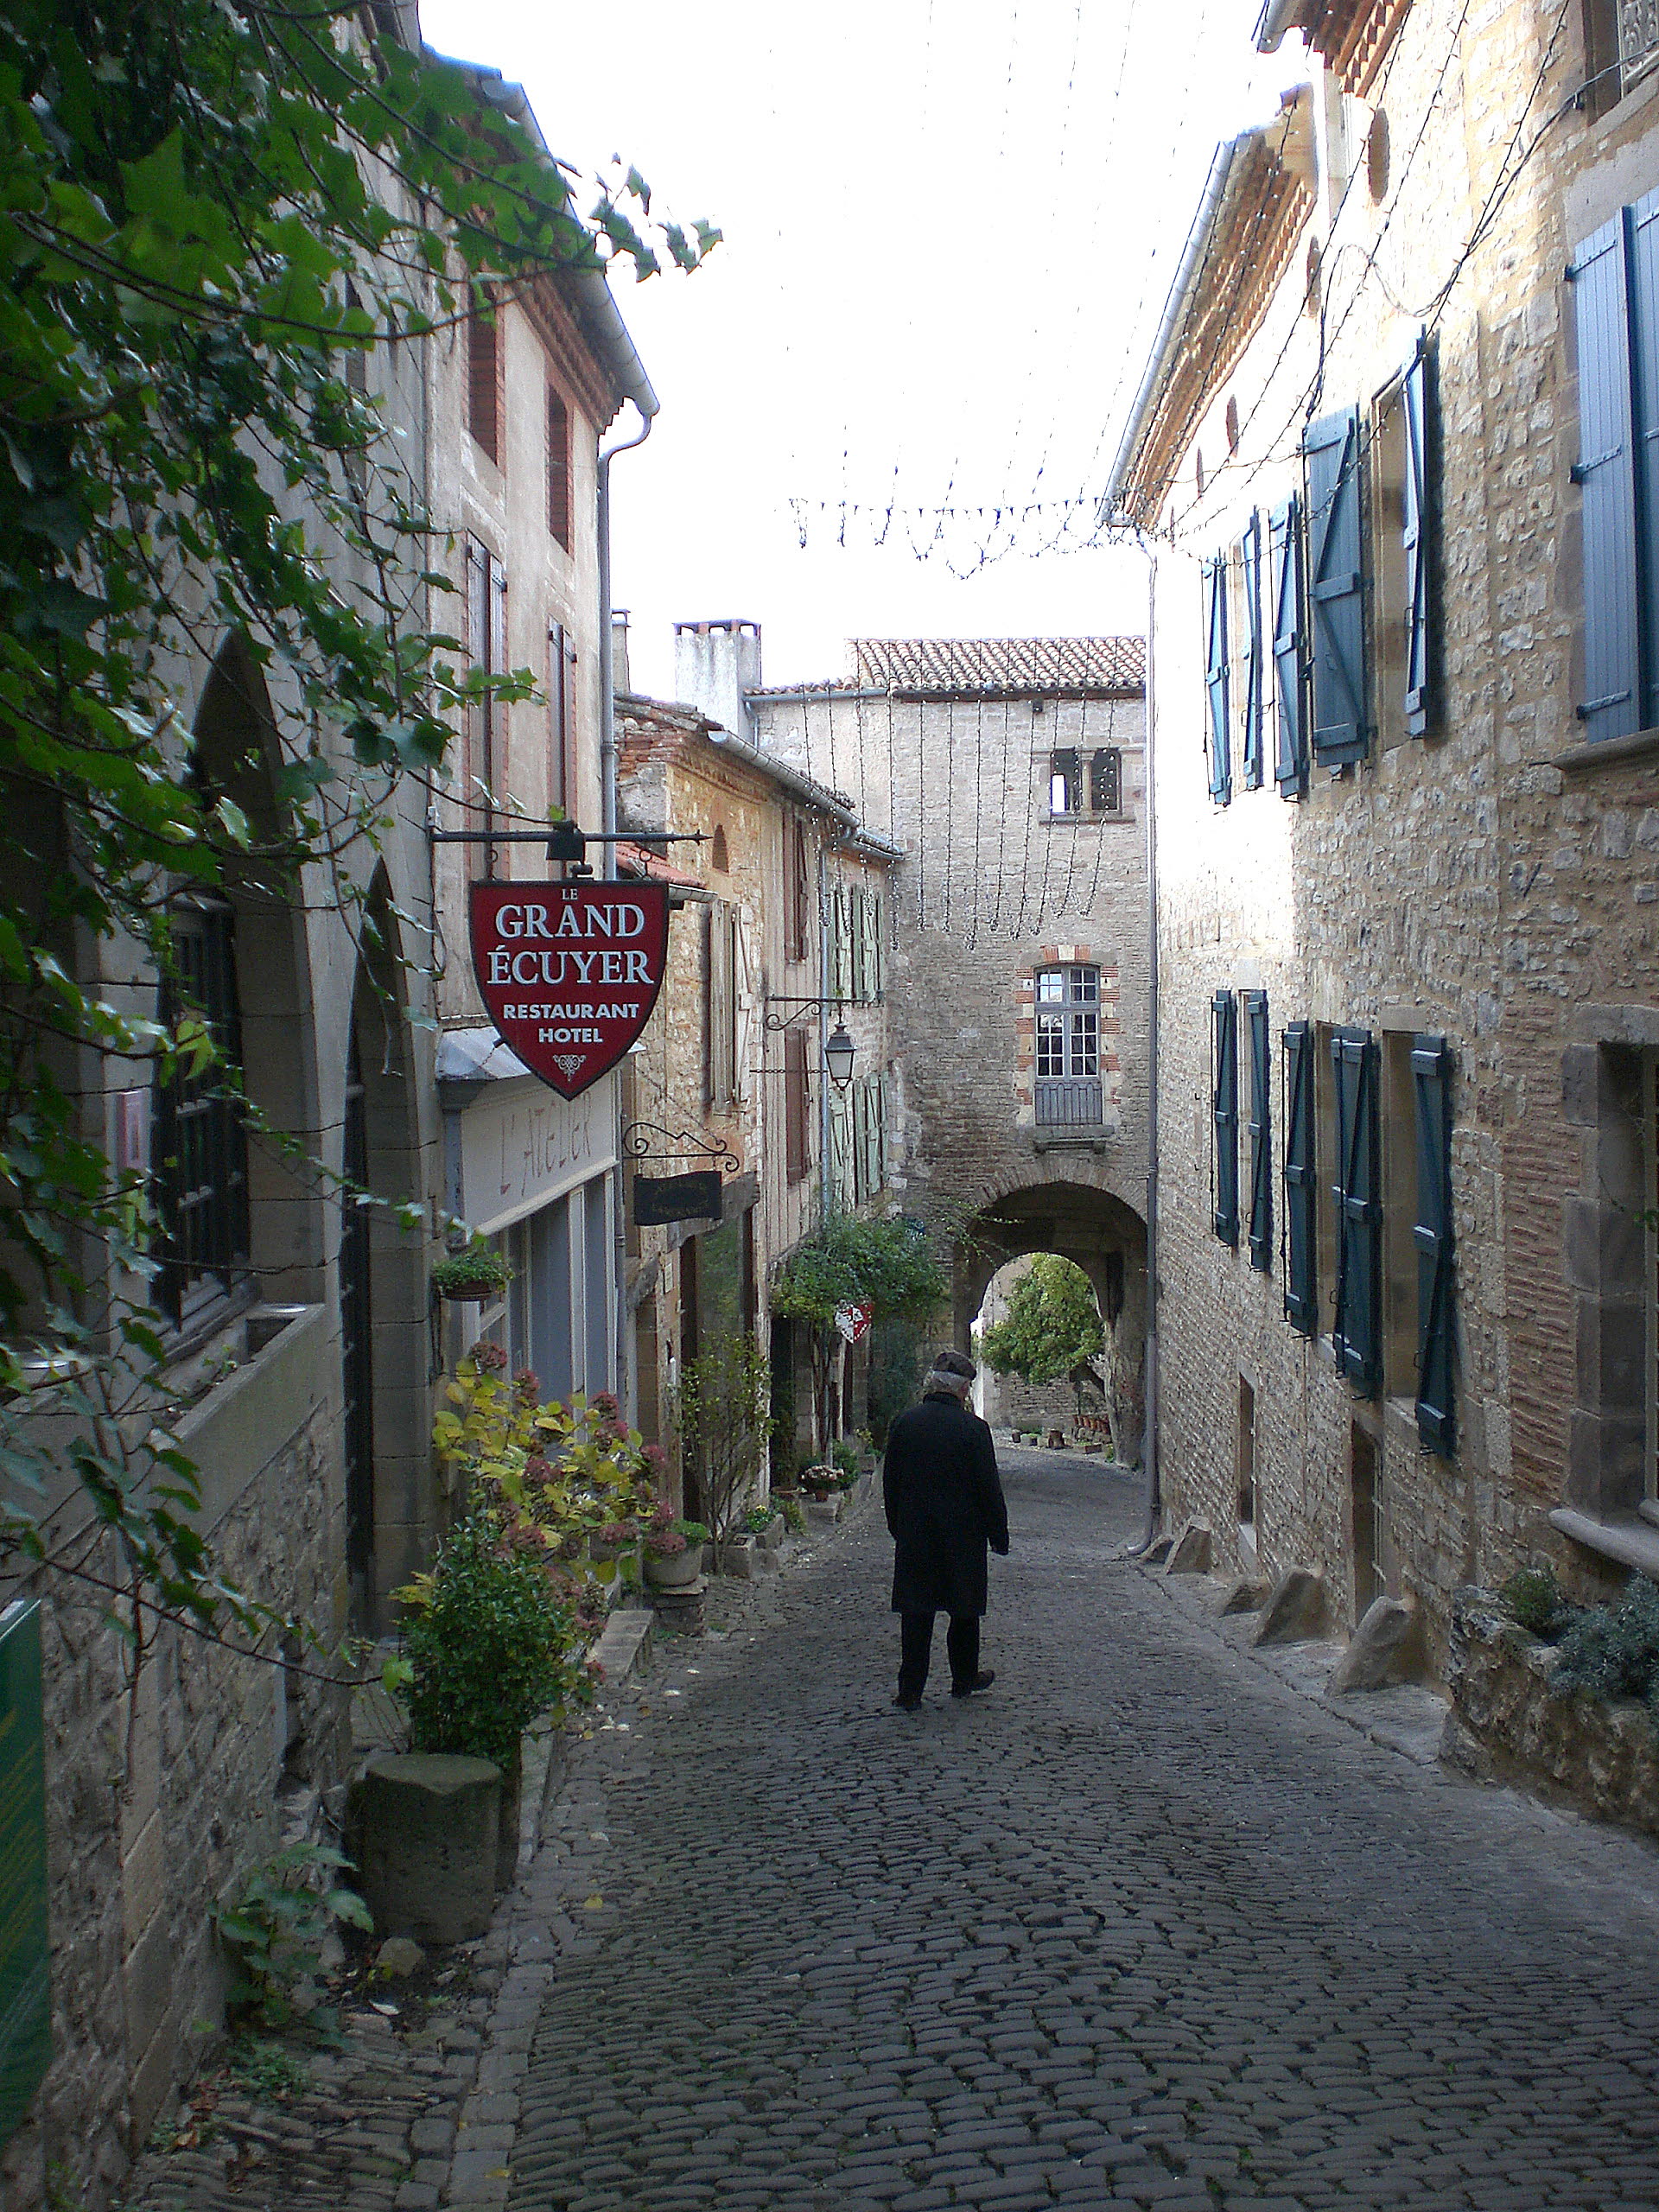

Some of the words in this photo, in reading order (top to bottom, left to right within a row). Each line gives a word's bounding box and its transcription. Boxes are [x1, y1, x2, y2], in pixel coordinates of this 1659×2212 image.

[562, 889, 578, 900] LE
[495, 904, 645, 938] GRAND
[486, 944, 654, 984] ÉCUYER
[503, 1003, 639, 1019] RESTAURANT
[538, 1028, 603, 1043] HOTEL
